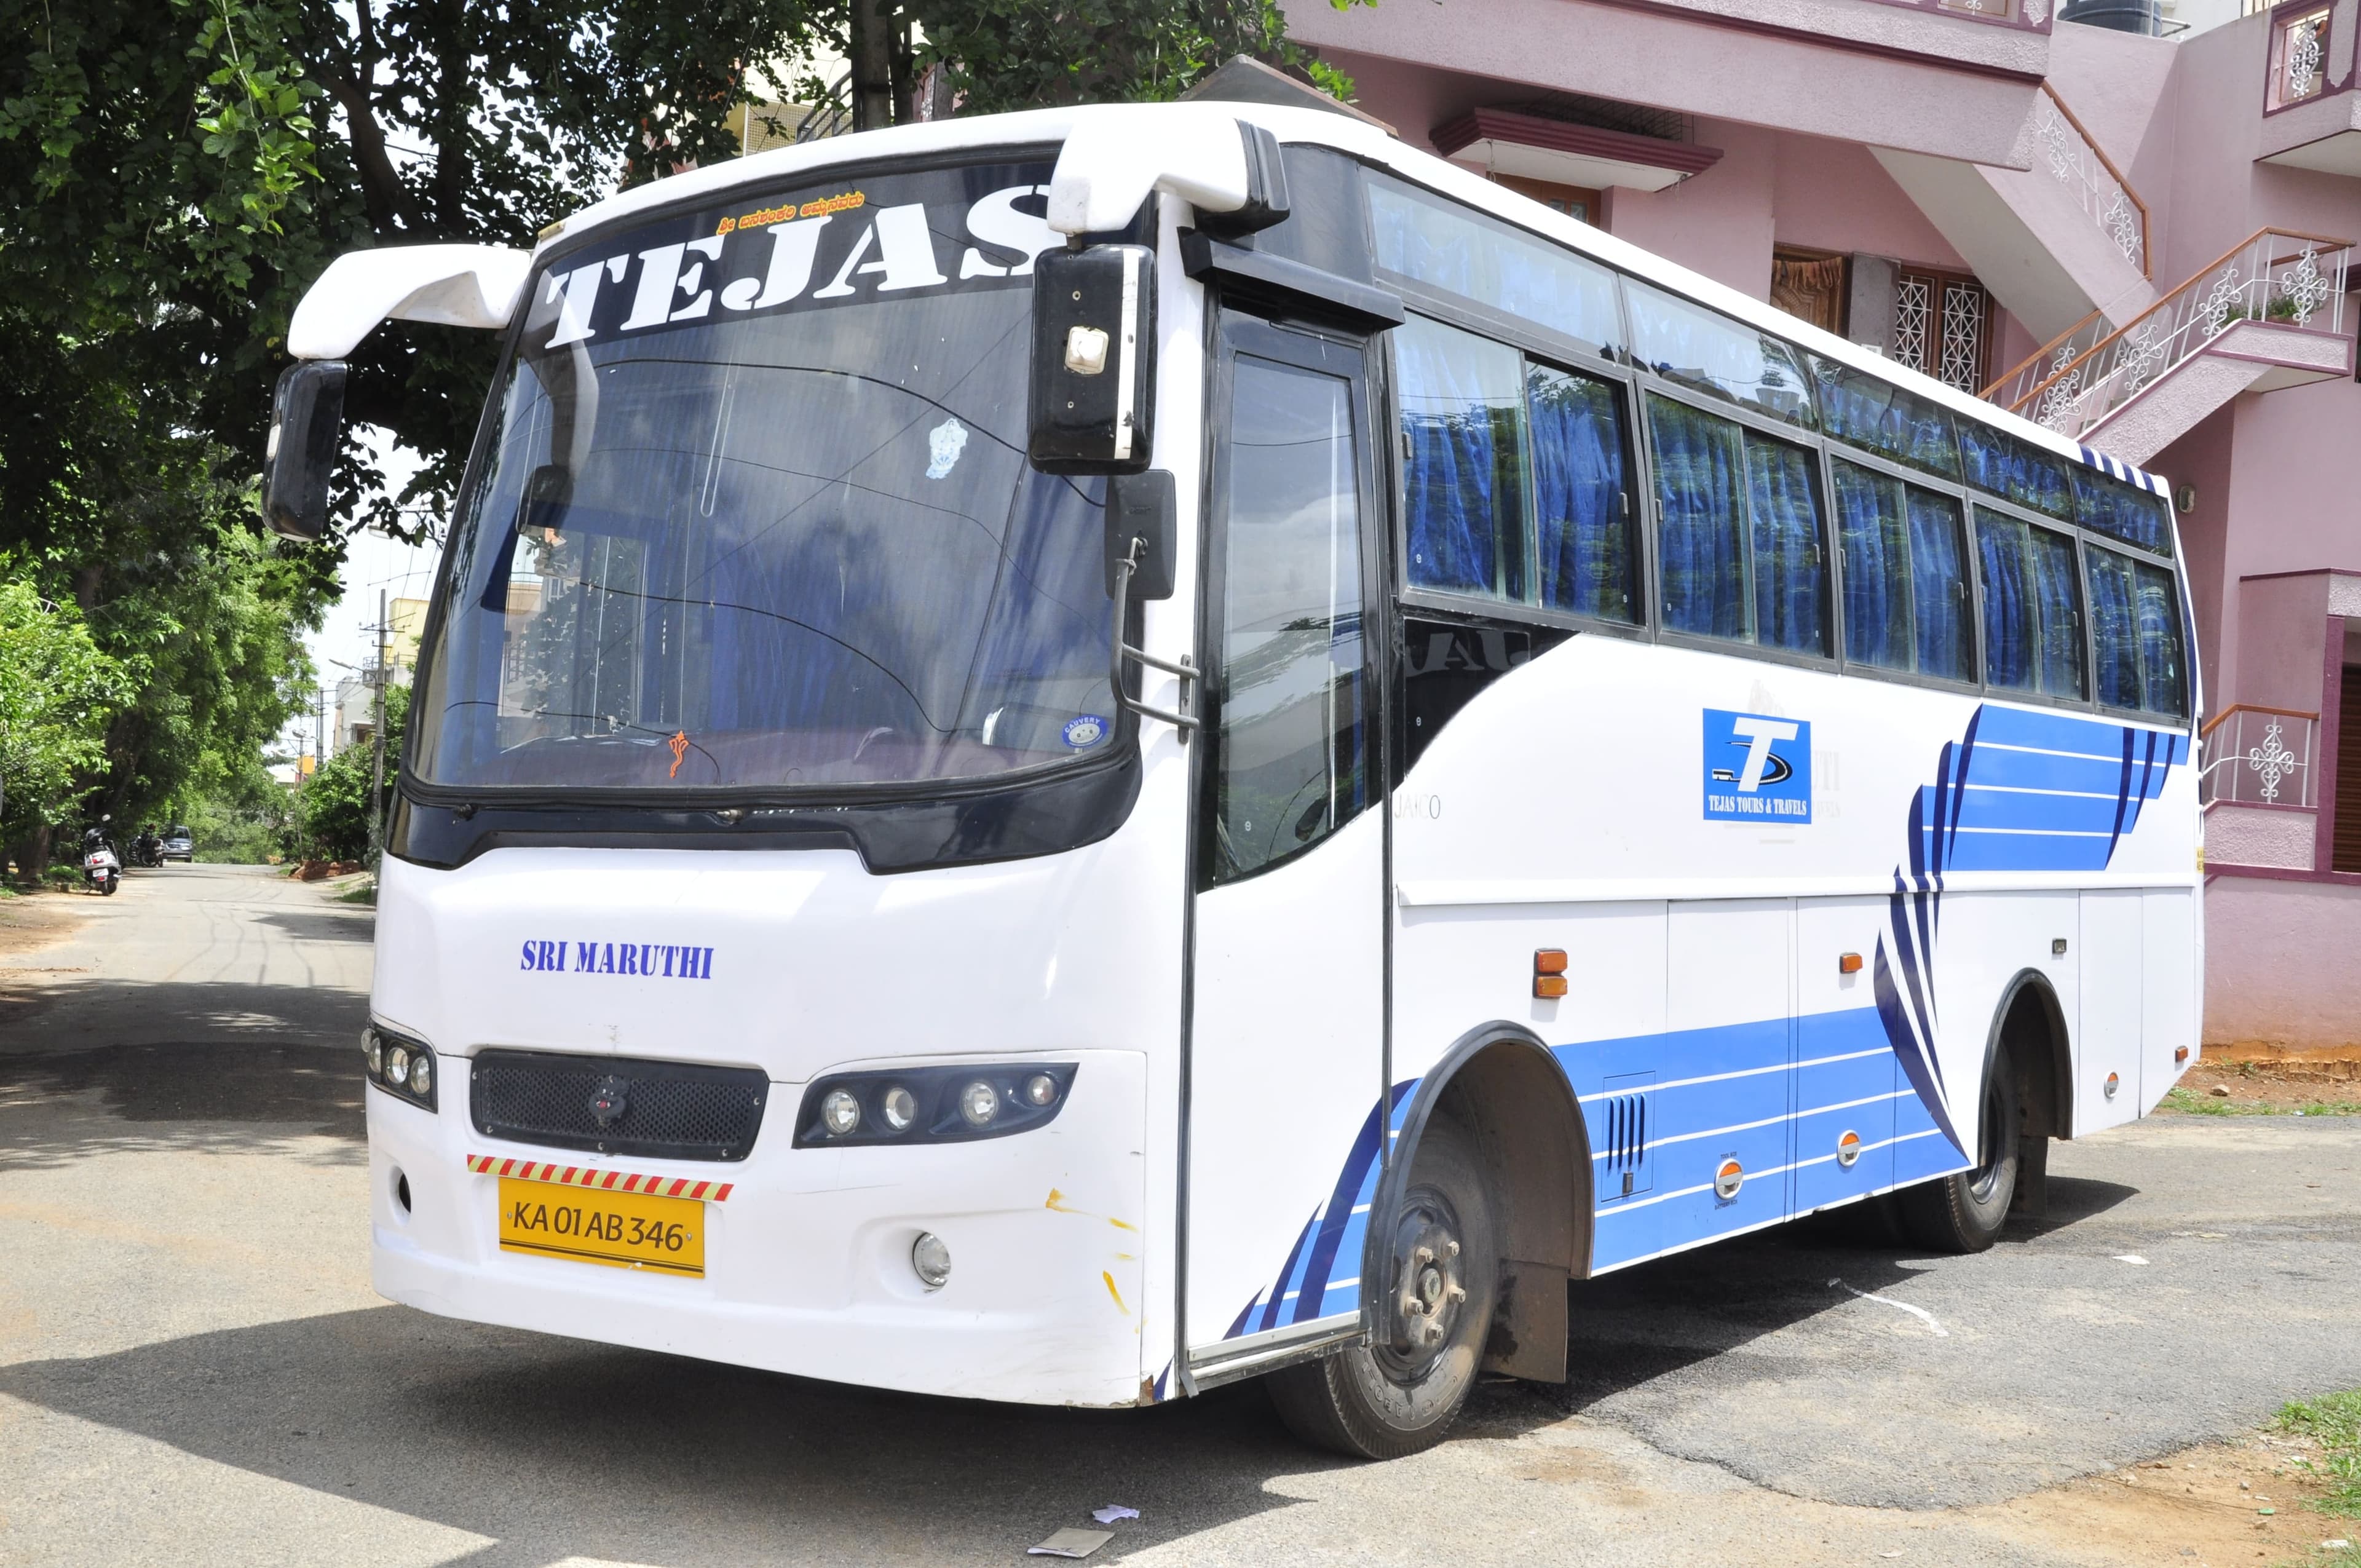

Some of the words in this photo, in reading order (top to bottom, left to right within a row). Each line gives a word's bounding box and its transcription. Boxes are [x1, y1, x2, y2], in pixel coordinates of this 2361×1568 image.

[716, 217, 736, 236] ಶ್ರೀ
[738, 204, 797, 229] ಬನಶಂಕರಿ
[545, 184, 1068, 349] TEJAS
[1064, 717, 1101, 733] CAUVERY
[1708, 794, 1735, 812] TEJAS
[1737, 796, 1764, 814] TOURS
[1765, 798, 1772, 814] &
[1773, 798, 1807, 816] TRAVELS
[521, 940, 568, 972] SRI
[574, 942, 714, 980] MARUTHI
